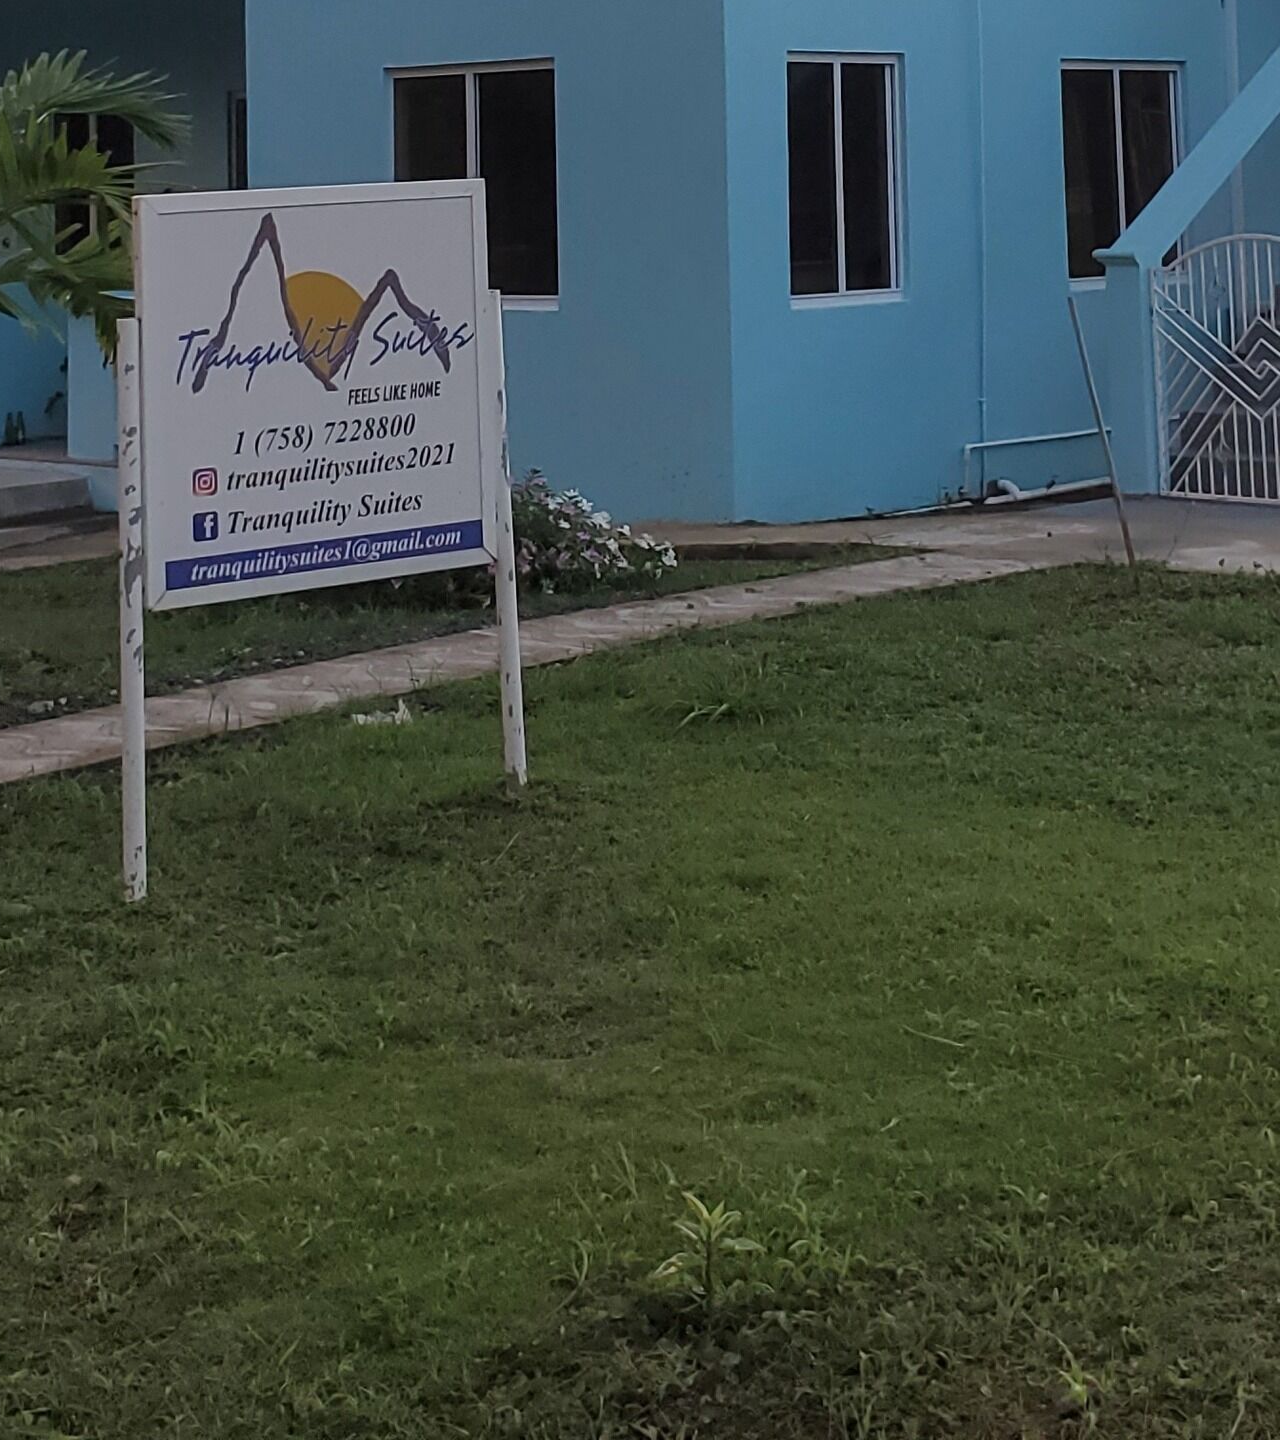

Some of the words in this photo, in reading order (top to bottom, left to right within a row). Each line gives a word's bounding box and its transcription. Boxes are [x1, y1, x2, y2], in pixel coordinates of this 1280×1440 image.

[177, 317, 359, 391] Tranquility
[370, 308, 474, 366] Suites
[348, 388, 380, 406] FEELS
[383, 385, 407, 402] LIKE
[410, 380, 441, 400] HOME
[233, 430, 245, 456] 1
[254, 423, 314, 457] (758)
[324, 412, 416, 446] 7228800
[227, 442, 455, 492] tranquilitysuites2021
[228, 501, 351, 535] Tranquility
[358, 492, 423, 519] Suites
[191, 528, 461, 581] tranquilitysuites1@gmail.com
